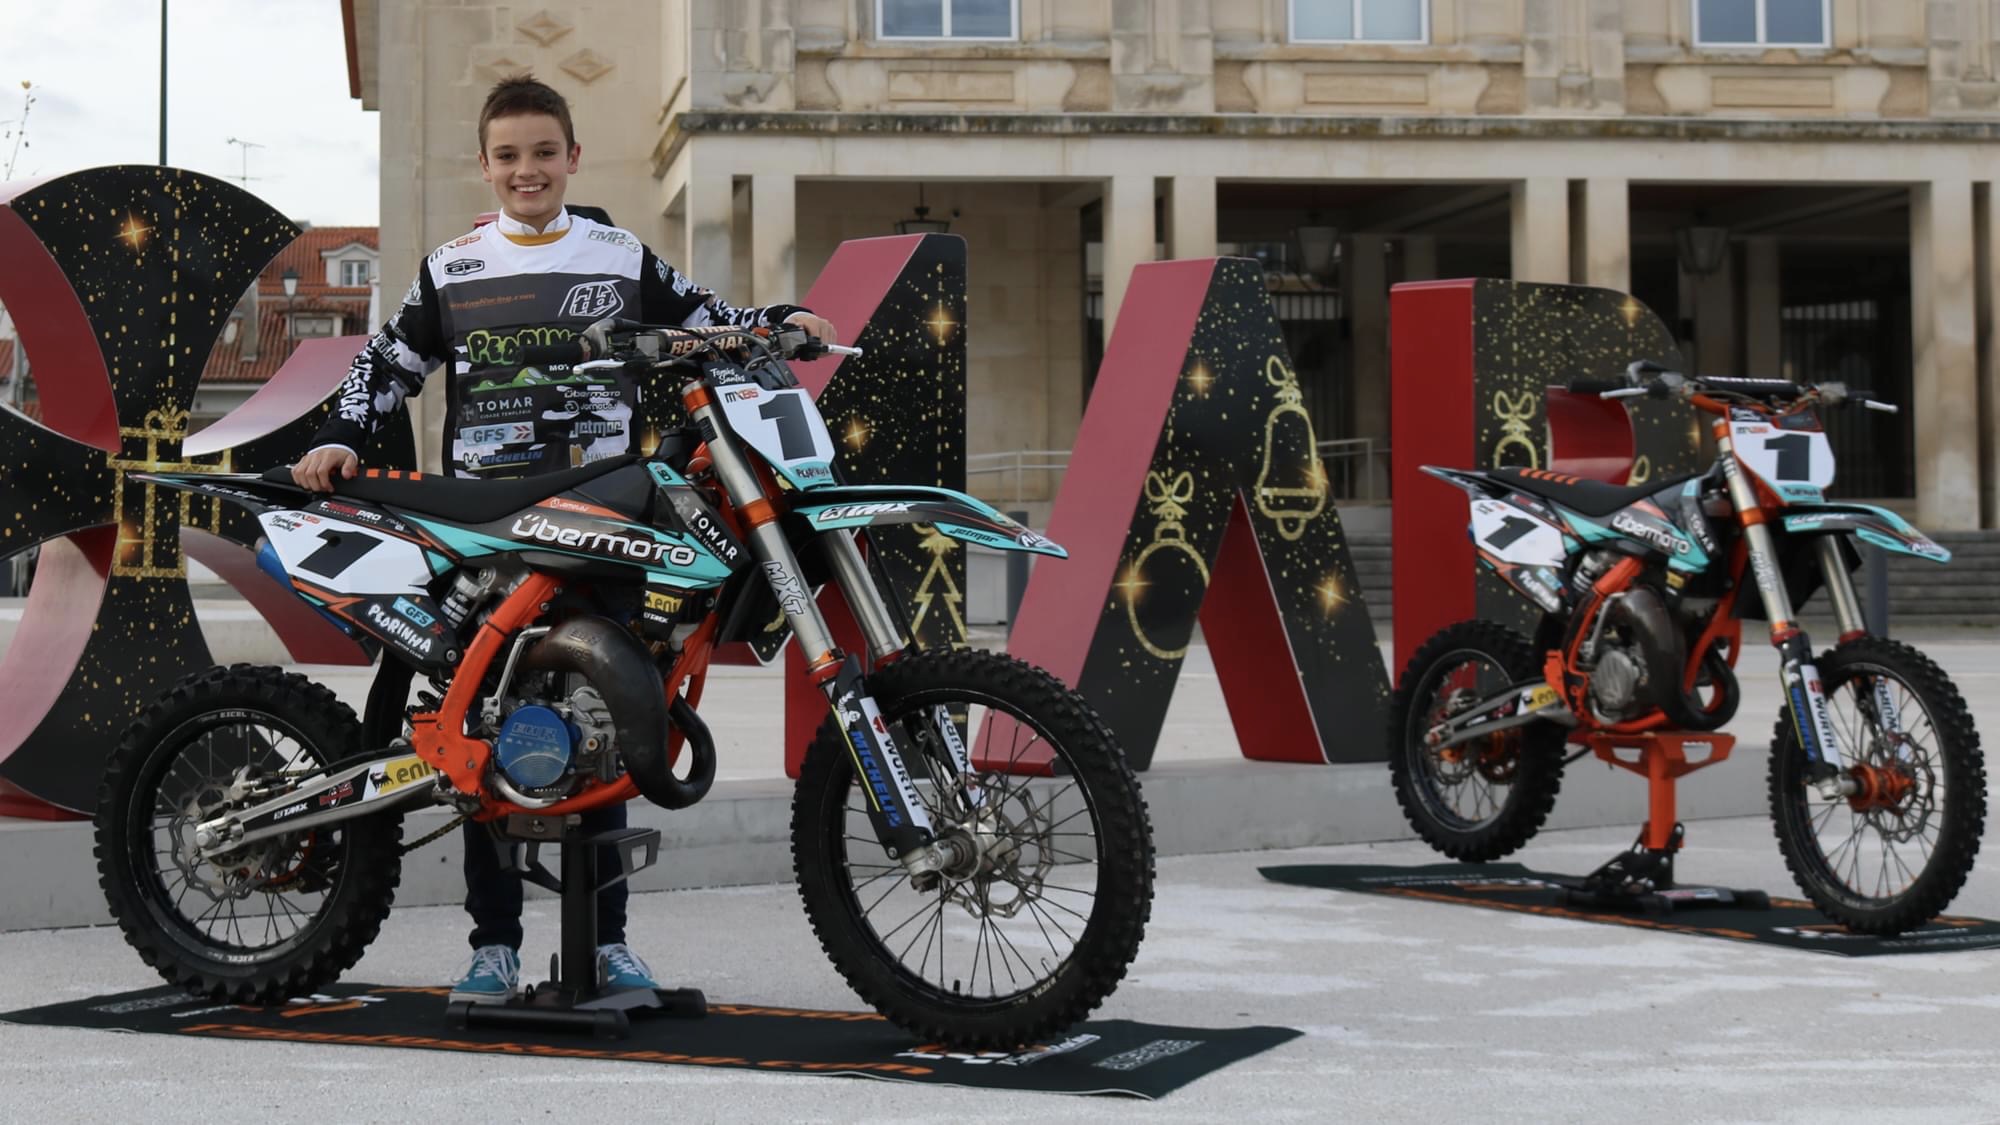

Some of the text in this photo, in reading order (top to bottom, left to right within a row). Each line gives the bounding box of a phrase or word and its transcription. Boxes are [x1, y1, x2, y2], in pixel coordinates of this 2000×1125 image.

[477, 396, 532, 412] TOMAR
[473, 428, 505, 443] GFS
[758, 393, 817, 461] 1
[481, 451, 543, 464] MICHELIN
[1764, 433, 1811, 482] 1
[691, 508, 737, 560] TOMAR
[1483, 515, 1539, 551] 1
[298, 528, 384, 580] 1
[405, 606, 430, 626] GFS
[396, 761, 430, 783] eni
[850, 730, 900, 828] MICHELIN
